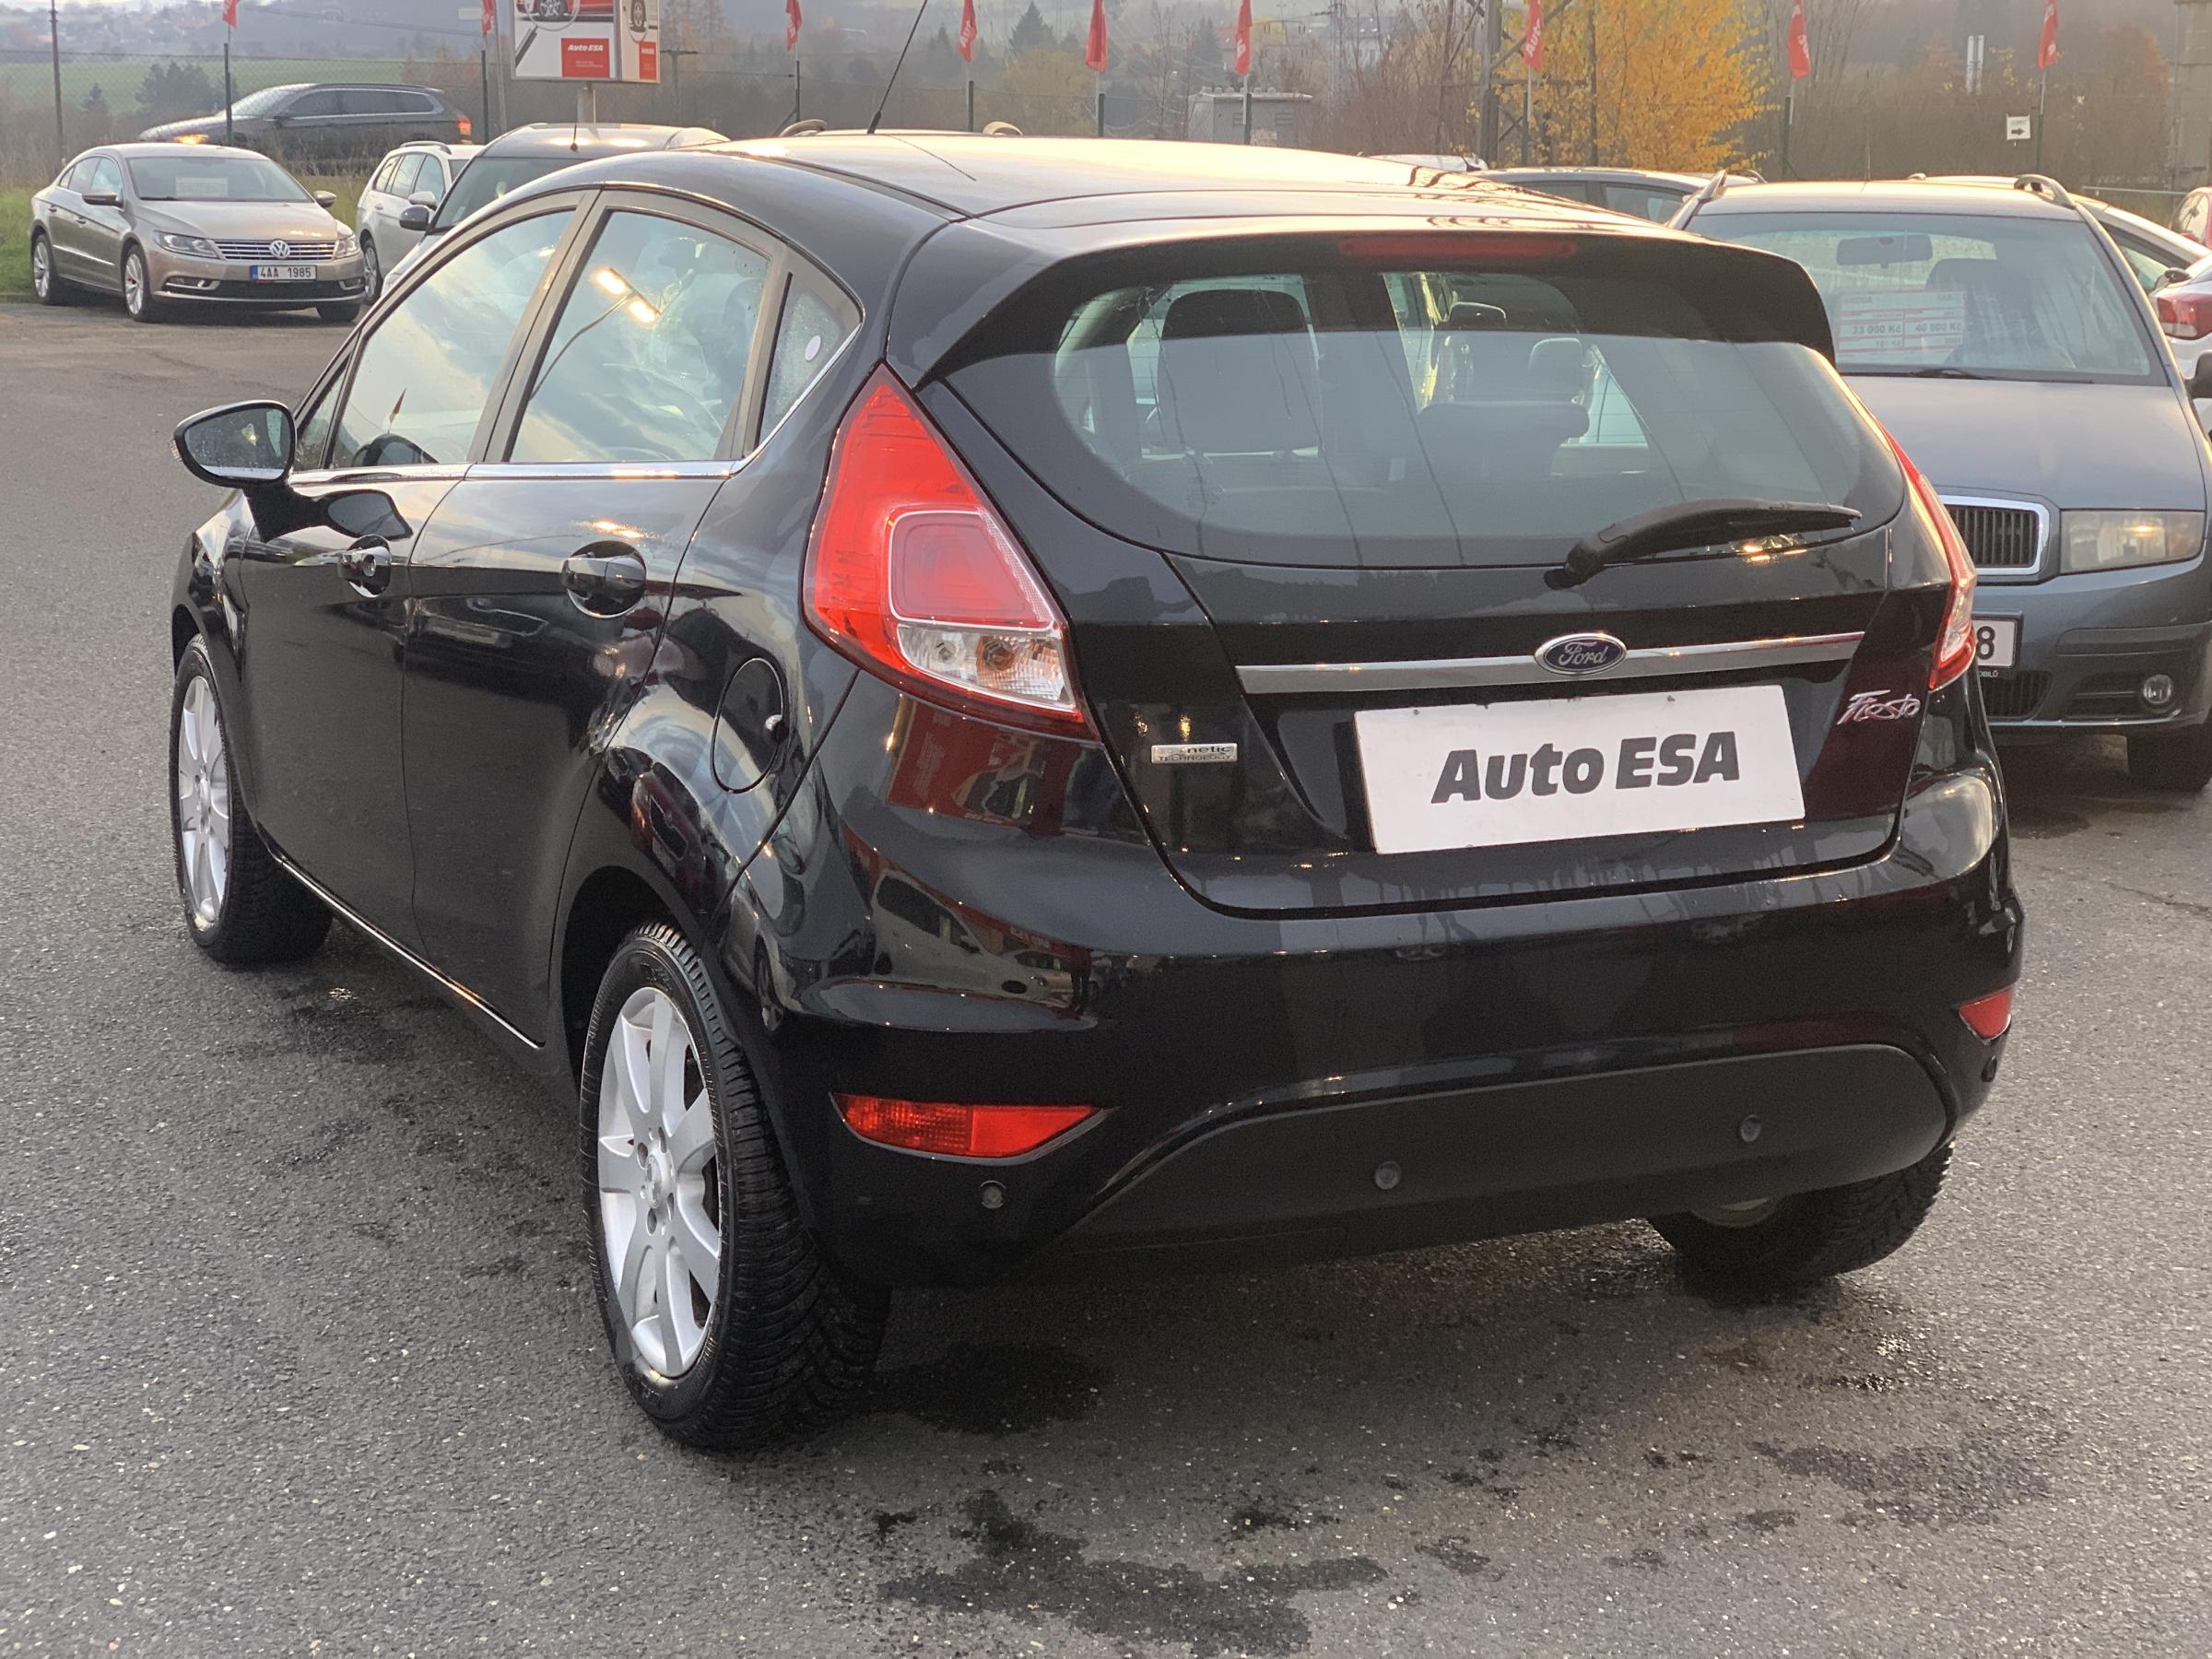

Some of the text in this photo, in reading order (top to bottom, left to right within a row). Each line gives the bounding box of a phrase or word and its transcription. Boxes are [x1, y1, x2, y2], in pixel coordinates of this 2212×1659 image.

[260, 266, 312, 277] 4AA 1985
[1559, 641, 1608, 665] Ford
[1836, 689, 1921, 725] Fiesta
[1430, 731, 1740, 804] Auto ESA
